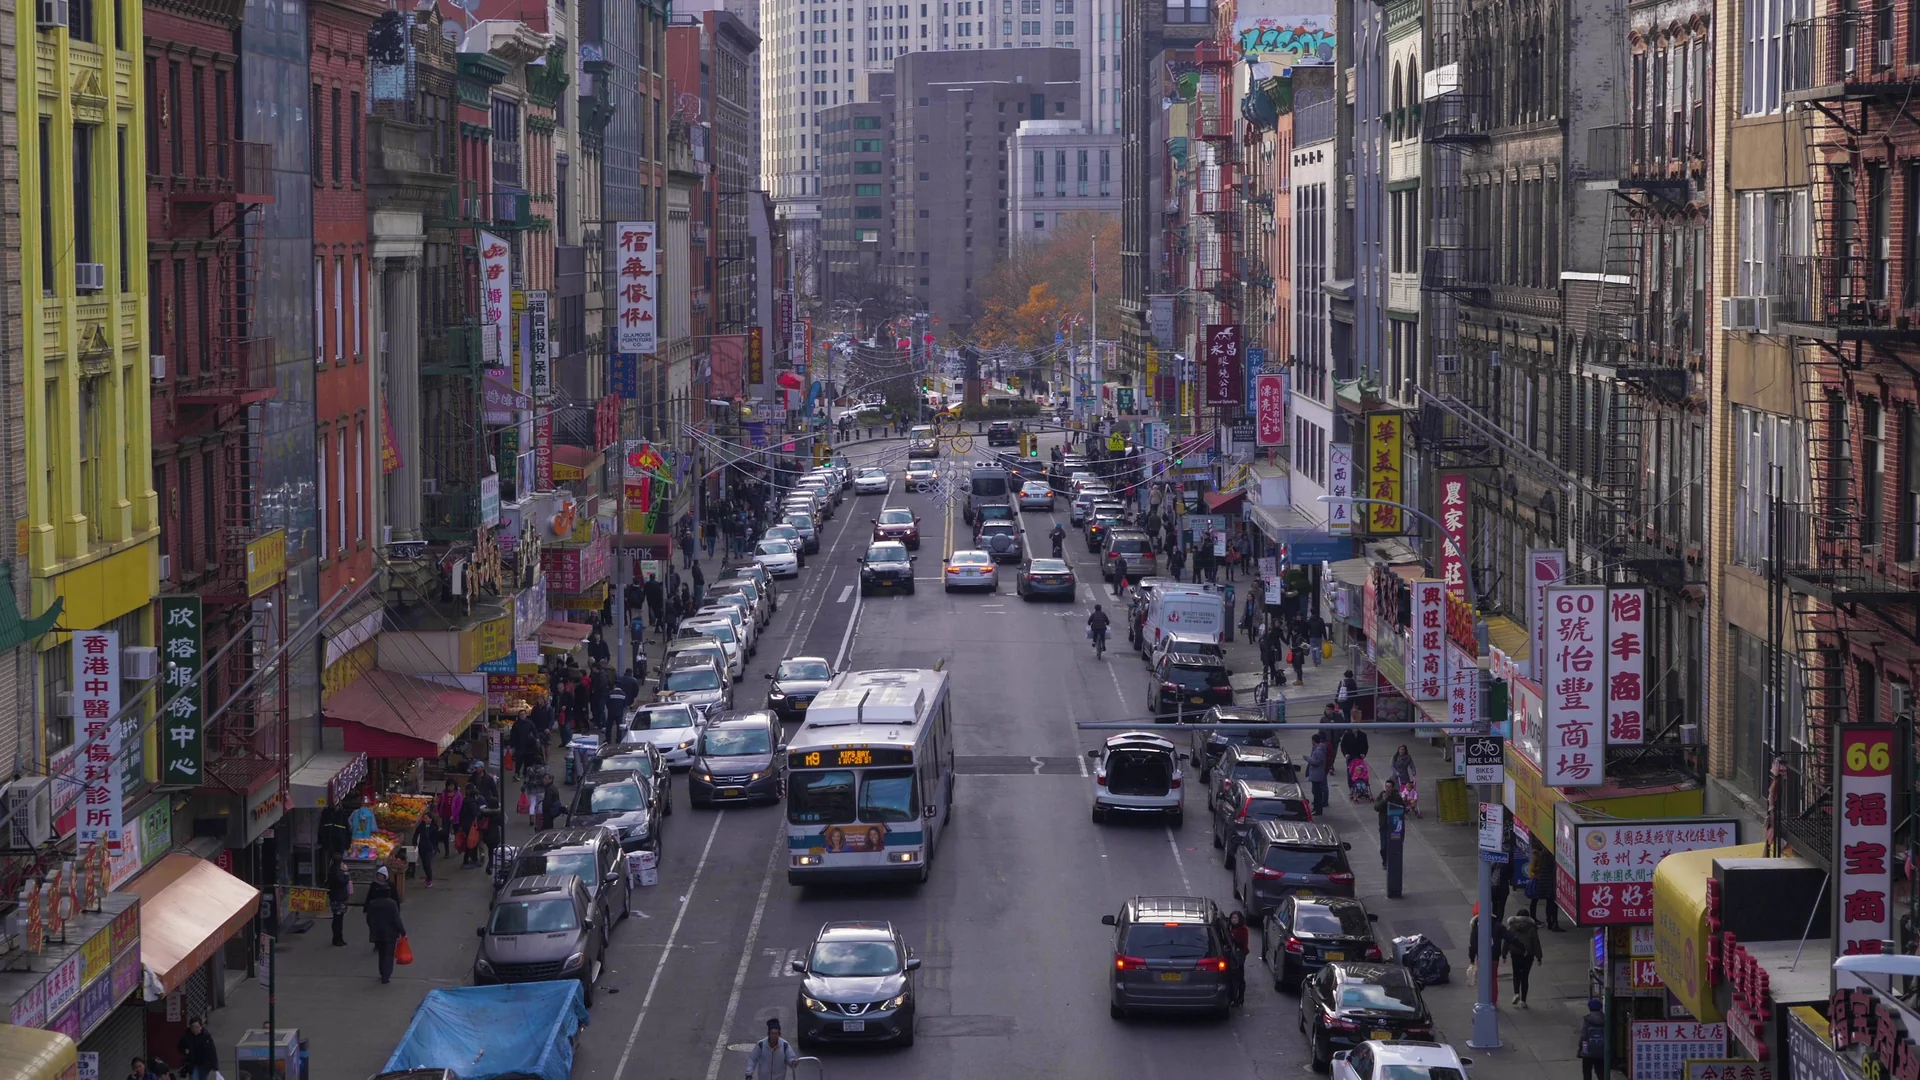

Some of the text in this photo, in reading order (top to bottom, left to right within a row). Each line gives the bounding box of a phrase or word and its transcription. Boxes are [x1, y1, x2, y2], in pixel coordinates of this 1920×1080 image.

[619, 231, 653, 328] 福華傢俬
[1261, 385, 1272, 435] 漂亮人生
[1372, 419, 1398, 529] 華美商場
[1442, 481, 1464, 585] 農家飯莊
[1421, 587, 1442, 698] 興旺旺商場
[167, 607, 198, 776] 欣榕服務中心
[82, 635, 113, 827] 香港中醫骨傷科診所
[805, 752, 820, 766] M9
[1846, 742, 1890, 771] 66
[1592, 908, 1605, 917] 62
[1622, 908, 1637, 917] TEL
[1639, 908, 1646, 917] &
[1636, 1024, 1724, 1040] 福州大花店
[1818, 1051, 1834, 1077] FOR
[1861, 1053, 1880, 1080] 66
